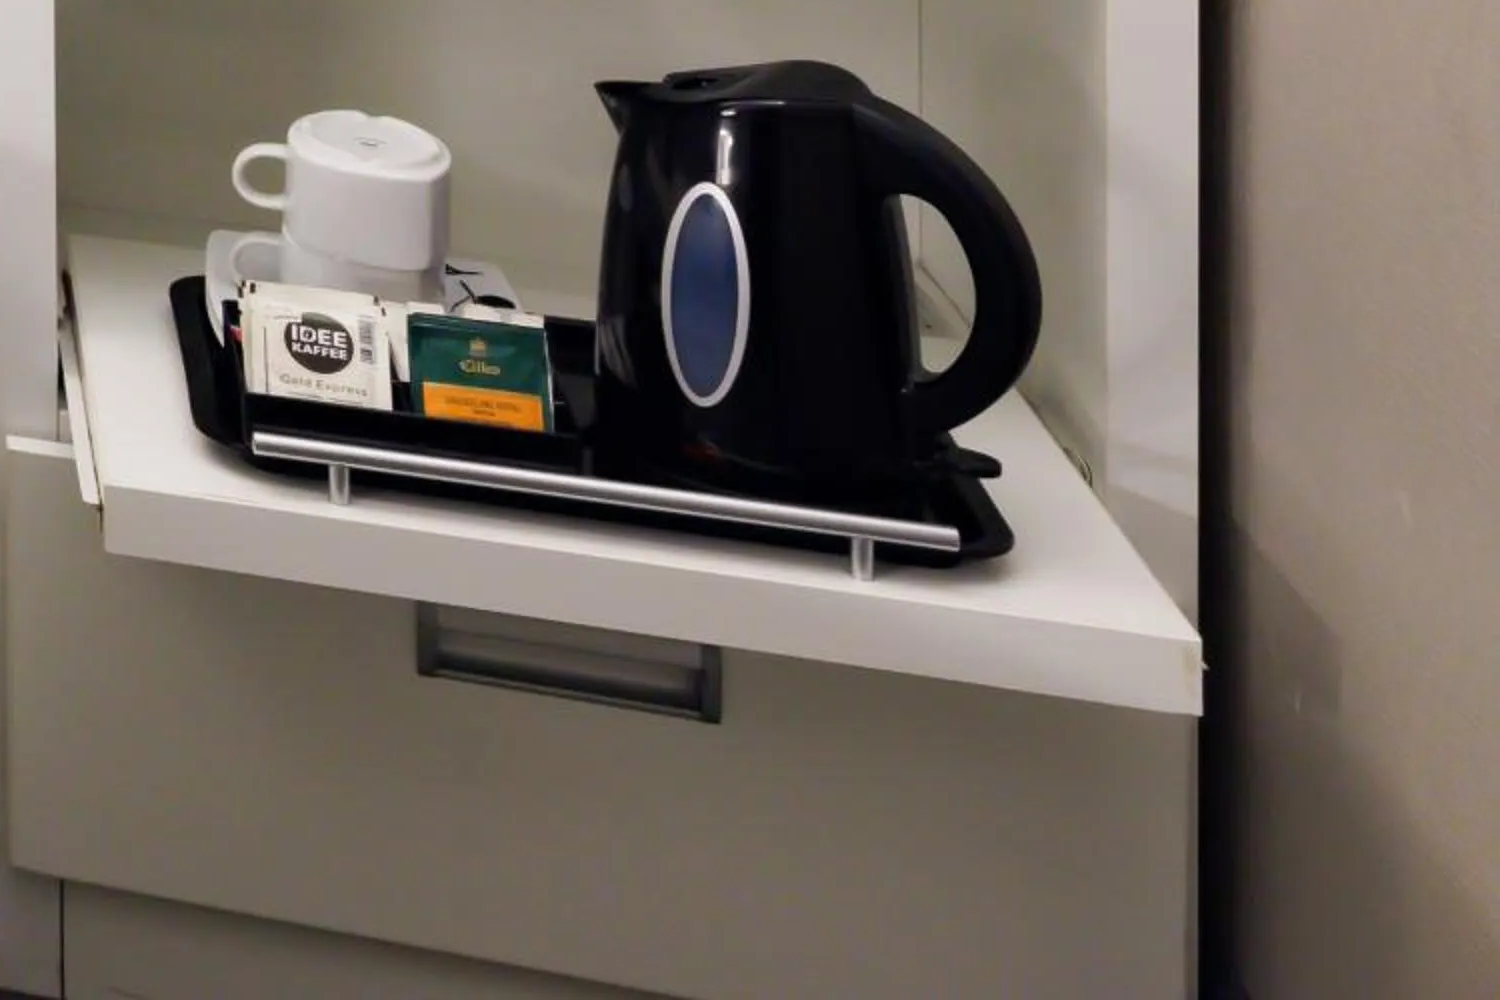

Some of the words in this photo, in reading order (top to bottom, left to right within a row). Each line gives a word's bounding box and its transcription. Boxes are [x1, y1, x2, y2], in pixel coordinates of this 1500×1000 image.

[290, 323, 348, 348] IDEE
[290, 342, 348, 361] KAFFEE
[279, 373, 313, 389] Gold
[315, 379, 368, 397] Express
